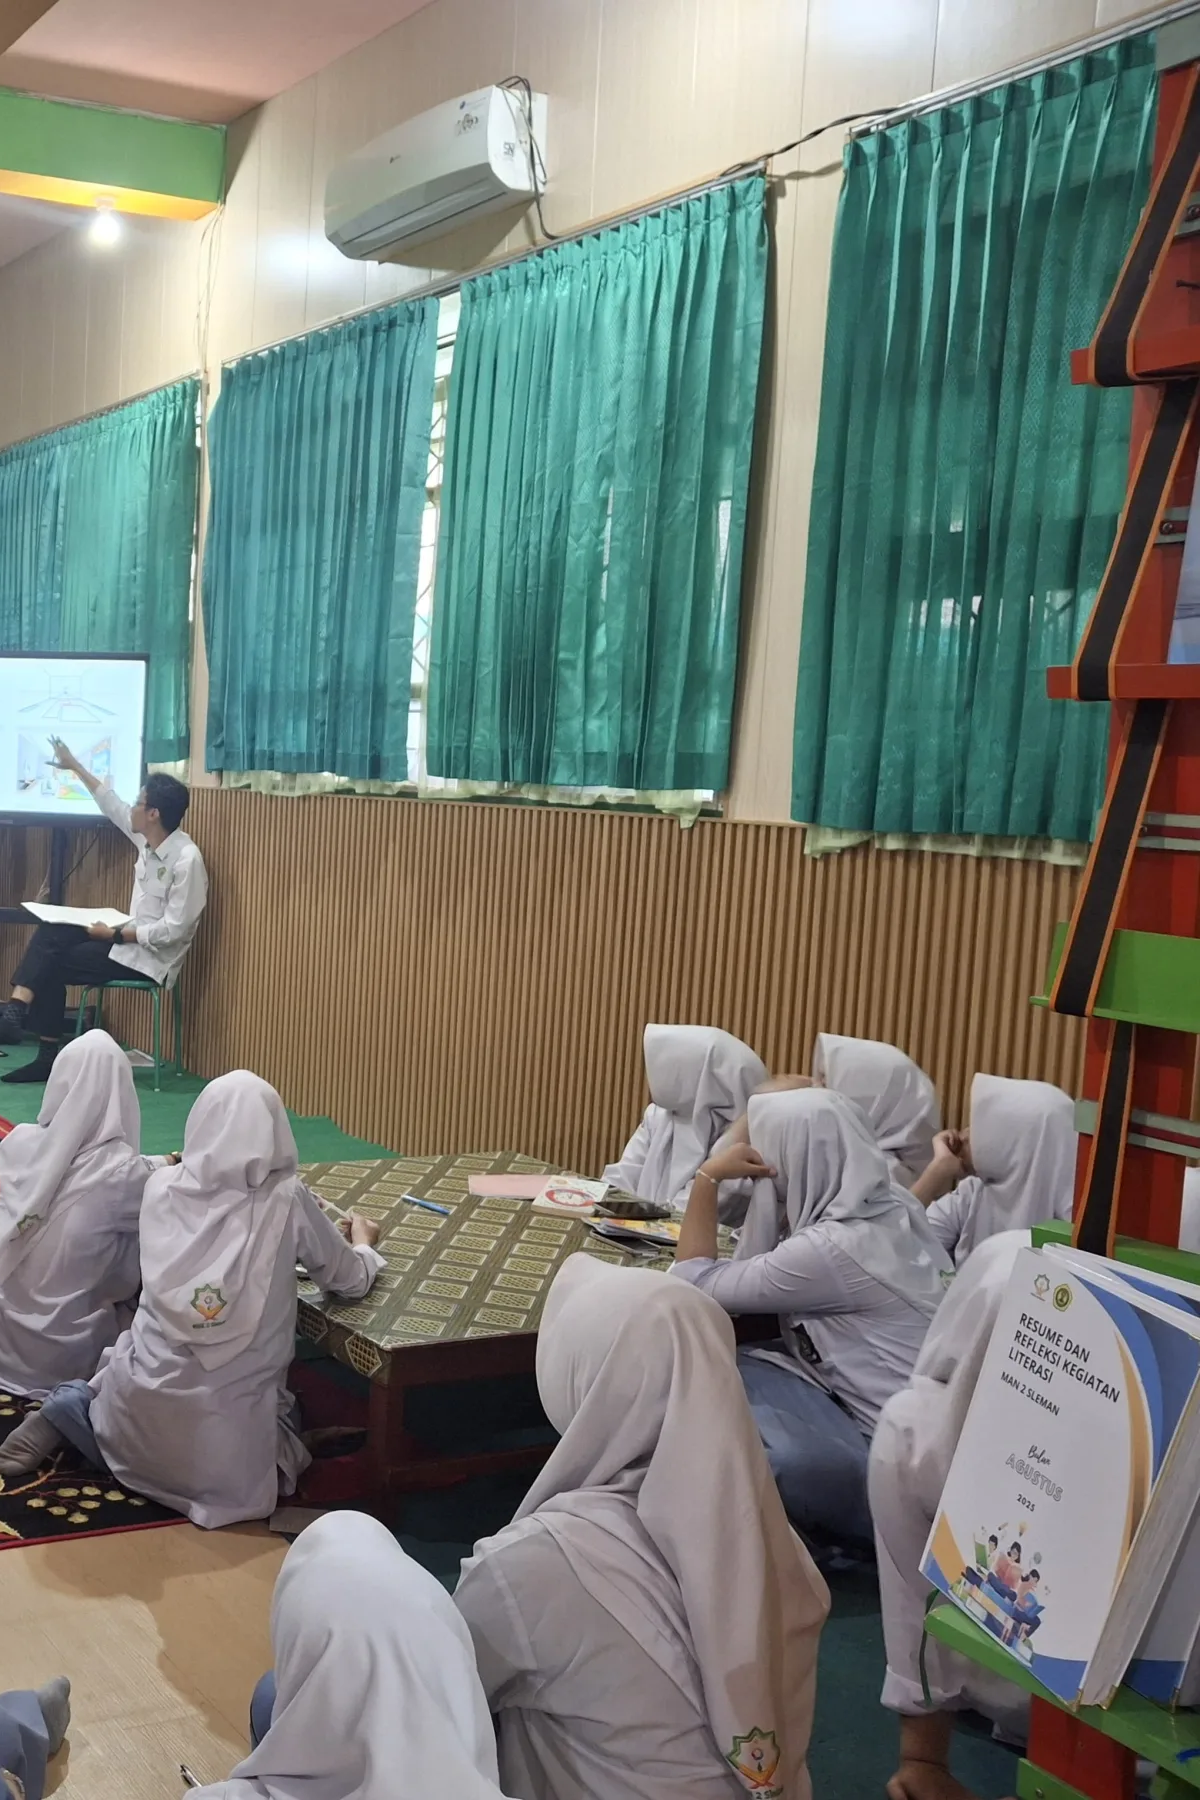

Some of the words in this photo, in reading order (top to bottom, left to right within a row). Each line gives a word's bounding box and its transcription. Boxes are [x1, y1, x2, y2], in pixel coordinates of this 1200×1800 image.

[1019, 1313, 1063, 1347] RESUME
[1064, 1338, 1090, 1363] DAN
[1008, 1347, 1053, 1383] LITERASI
[1014, 1330, 1061, 1367] REFLEKSI
[1062, 1359, 1120, 1403] KEGIATAN
[1000, 1372, 1020, 1390] MAN
[1020, 1384, 1026, 1394] 2
[1026, 1388, 1060, 1416] SLEMAN
[1005, 1453, 1064, 1502] AGUSTUS
[1016, 1493, 1036, 1512] 2025
